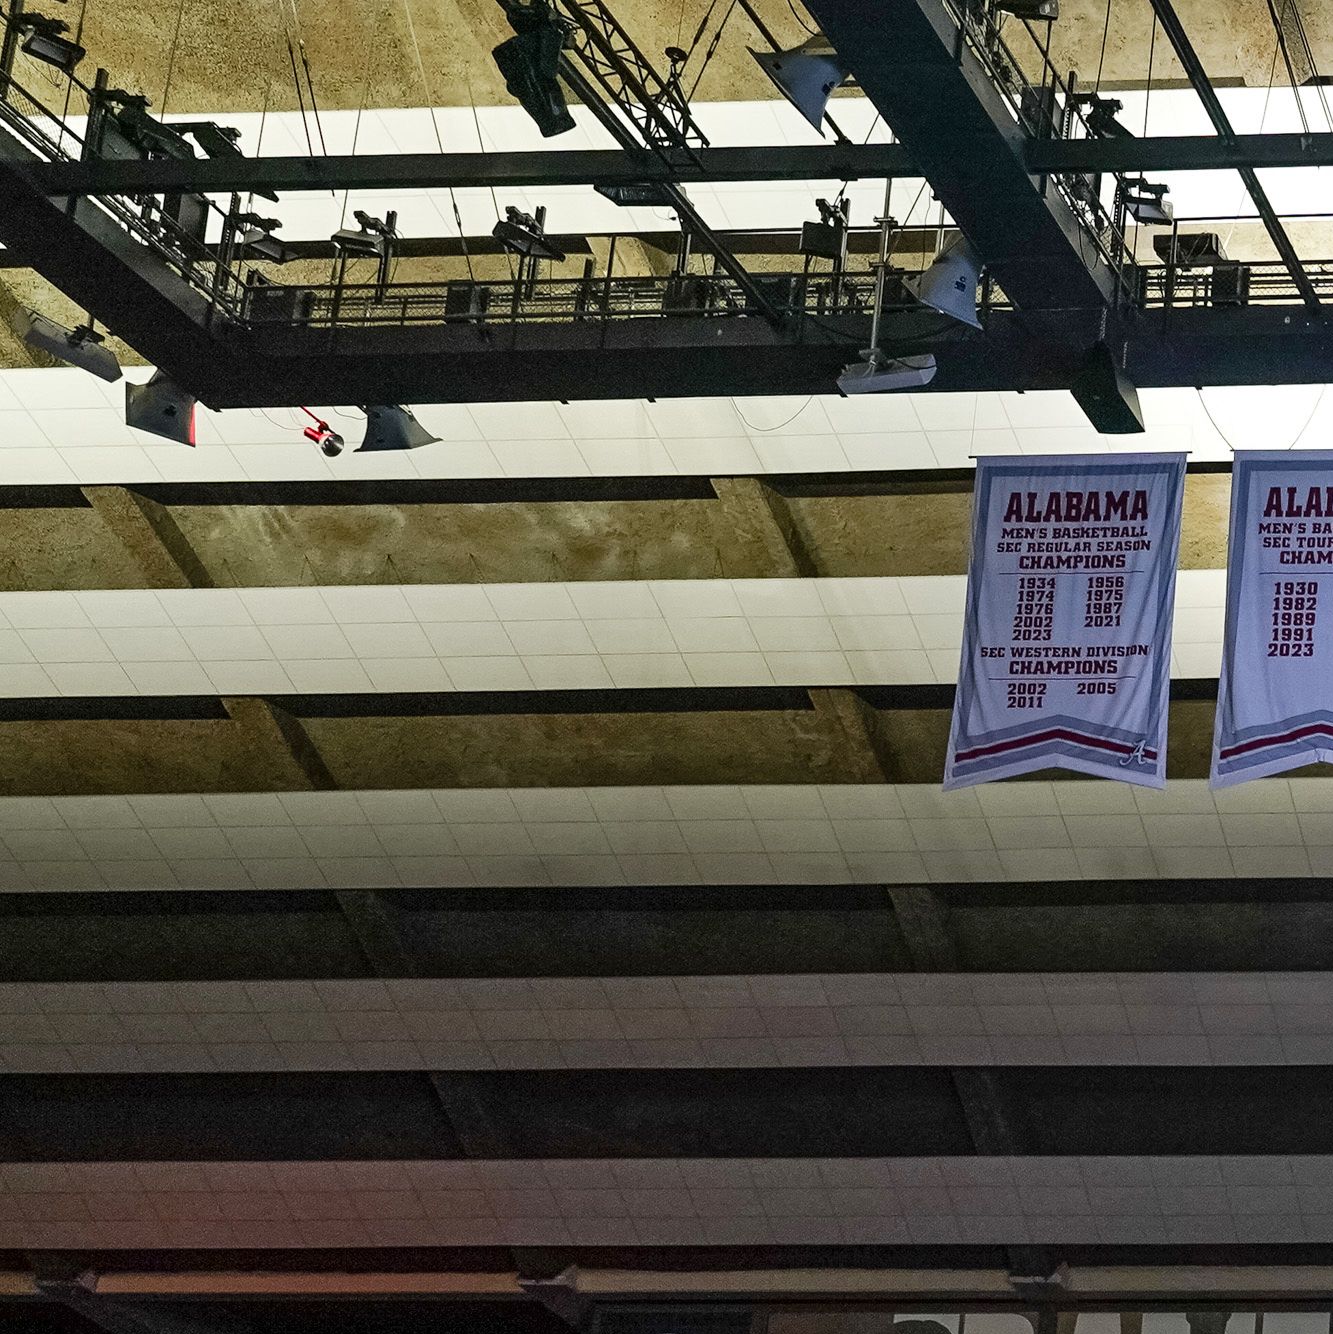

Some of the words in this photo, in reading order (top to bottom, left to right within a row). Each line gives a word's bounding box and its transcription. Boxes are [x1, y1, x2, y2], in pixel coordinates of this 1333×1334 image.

[1003, 489, 1148, 523] ALABAMA
[1001, 527, 1047, 539] MEN'S
[1052, 525, 1148, 539] BASKETBALL
[1258, 523, 1306, 534] MEN'S
[997, 542, 1021, 553] SEC
[1027, 541, 1092, 553] REGULAR
[1096, 540, 1151, 552] SEASON
[1262, 537, 1291, 548] SEC
[1019, 554, 1126, 569] CHAMPIONS
[1019, 577, 1056, 589] 1934
[1087, 576, 1124, 589] 1956
[1274, 582, 1318, 595] 1930
[1018, 590, 1055, 602] 1974
[1086, 589, 1124, 602] 1975
[1016, 602, 1054, 615] 1976
[1085, 602, 1123, 614] 1987
[1273, 597, 1316, 611] 1982
[1013, 616, 1053, 628] 2002
[1084, 615, 1121, 628] 2021
[1272, 612, 1316, 626] 1989
[1012, 629, 1052, 641] 2023
[1272, 628, 1313, 641] 1991
[981, 647, 1006, 658] SEC
[1010, 646, 1081, 658] WESTERN
[1086, 645, 1150, 658] DIVISION
[1267, 643, 1314, 657] 2023
[1009, 660, 1118, 675] CHAMPIONS
[1007, 683, 1047, 695] 2002
[1077, 682, 1116, 695] 2005
[1007, 696, 1043, 709] 2011
